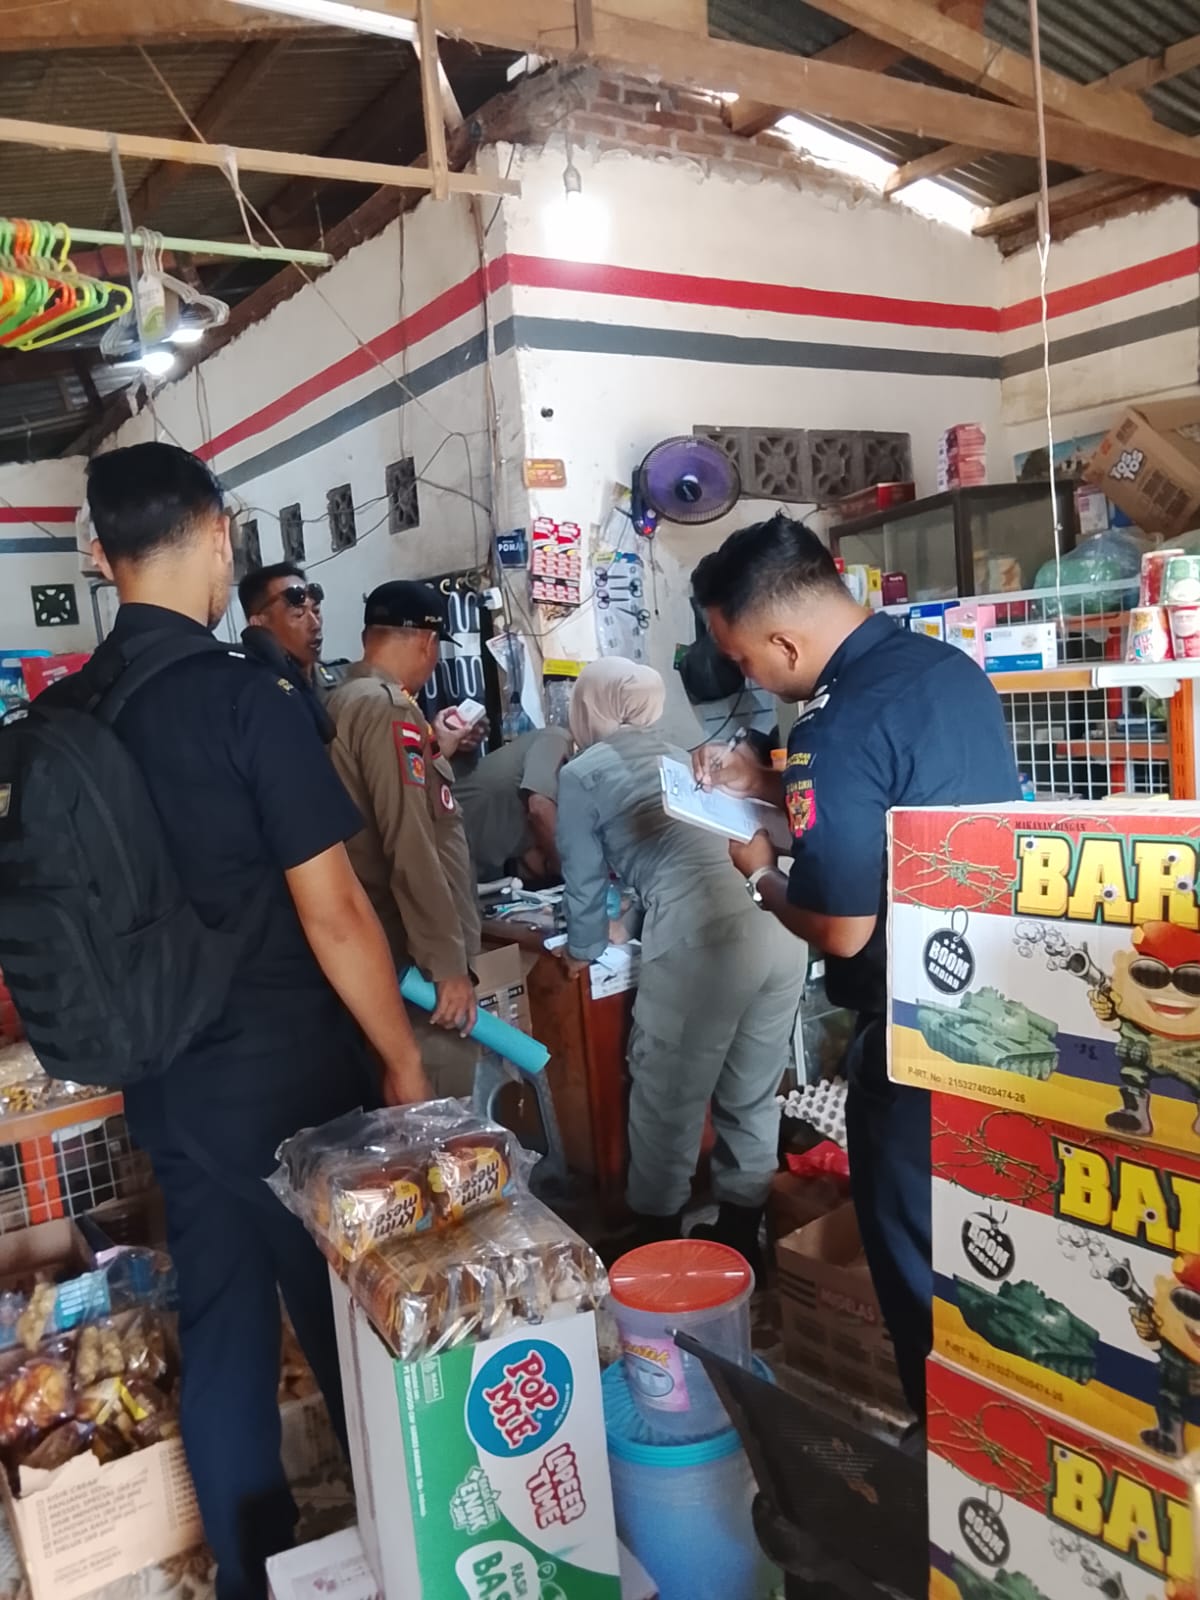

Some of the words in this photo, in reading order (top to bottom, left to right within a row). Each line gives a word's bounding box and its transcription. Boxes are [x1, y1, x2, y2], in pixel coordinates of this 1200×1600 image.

[928, 939, 970, 980] BOOM
[461, 1172, 499, 1207] Krim
[373, 1206, 417, 1240] Krim
[966, 1223, 1010, 1269] BOOM
[504, 1349, 560, 1412] POP
[483, 1379, 541, 1448] MIE
[459, 1481, 489, 1532] ENAK
[526, 1465, 563, 1530] TIME
[963, 1505, 1006, 1557] BOOM
